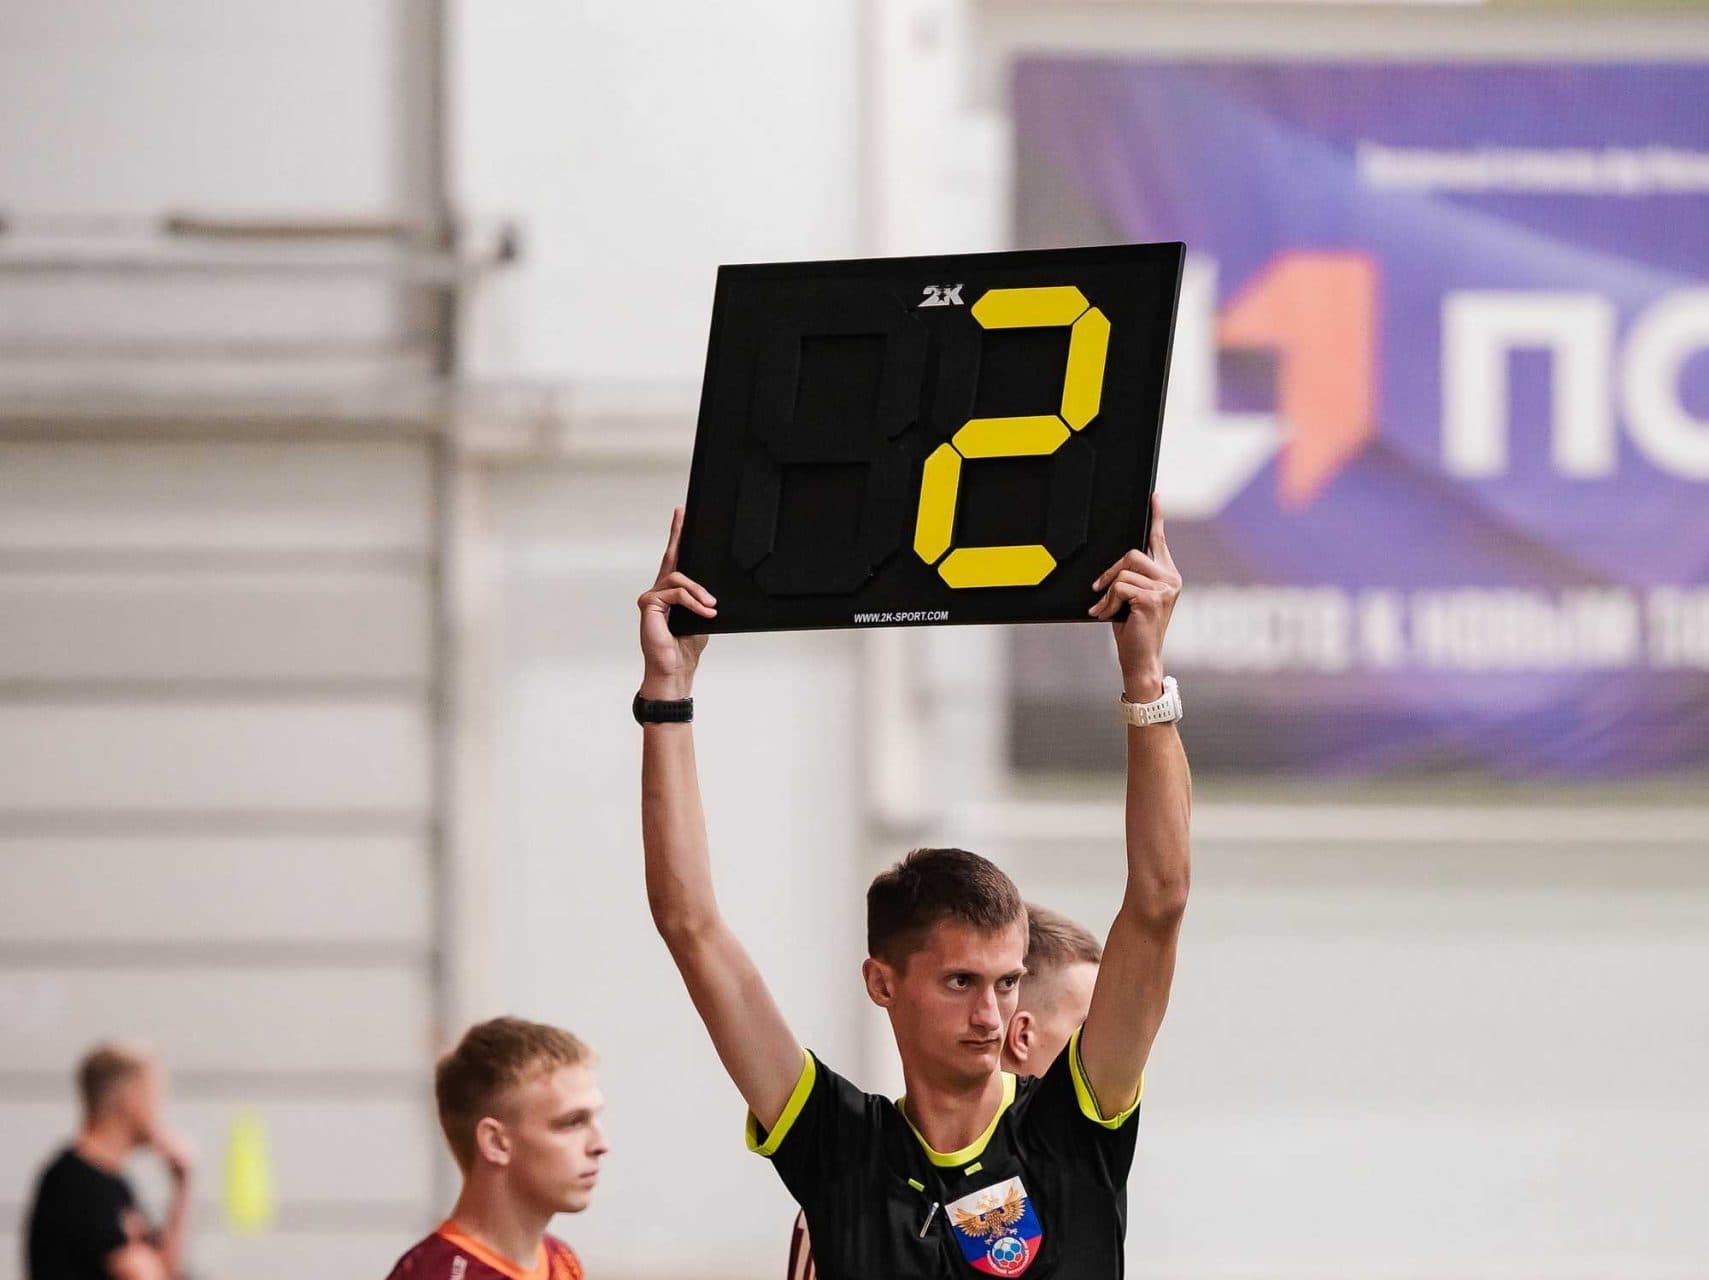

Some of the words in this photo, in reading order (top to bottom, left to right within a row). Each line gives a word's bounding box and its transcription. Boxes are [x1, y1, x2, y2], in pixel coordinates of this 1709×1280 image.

[917, 283, 965, 308] 2K
[913, 285, 1112, 590] 2
[854, 610, 949, 623] WWW.2K-SPORT.COM
